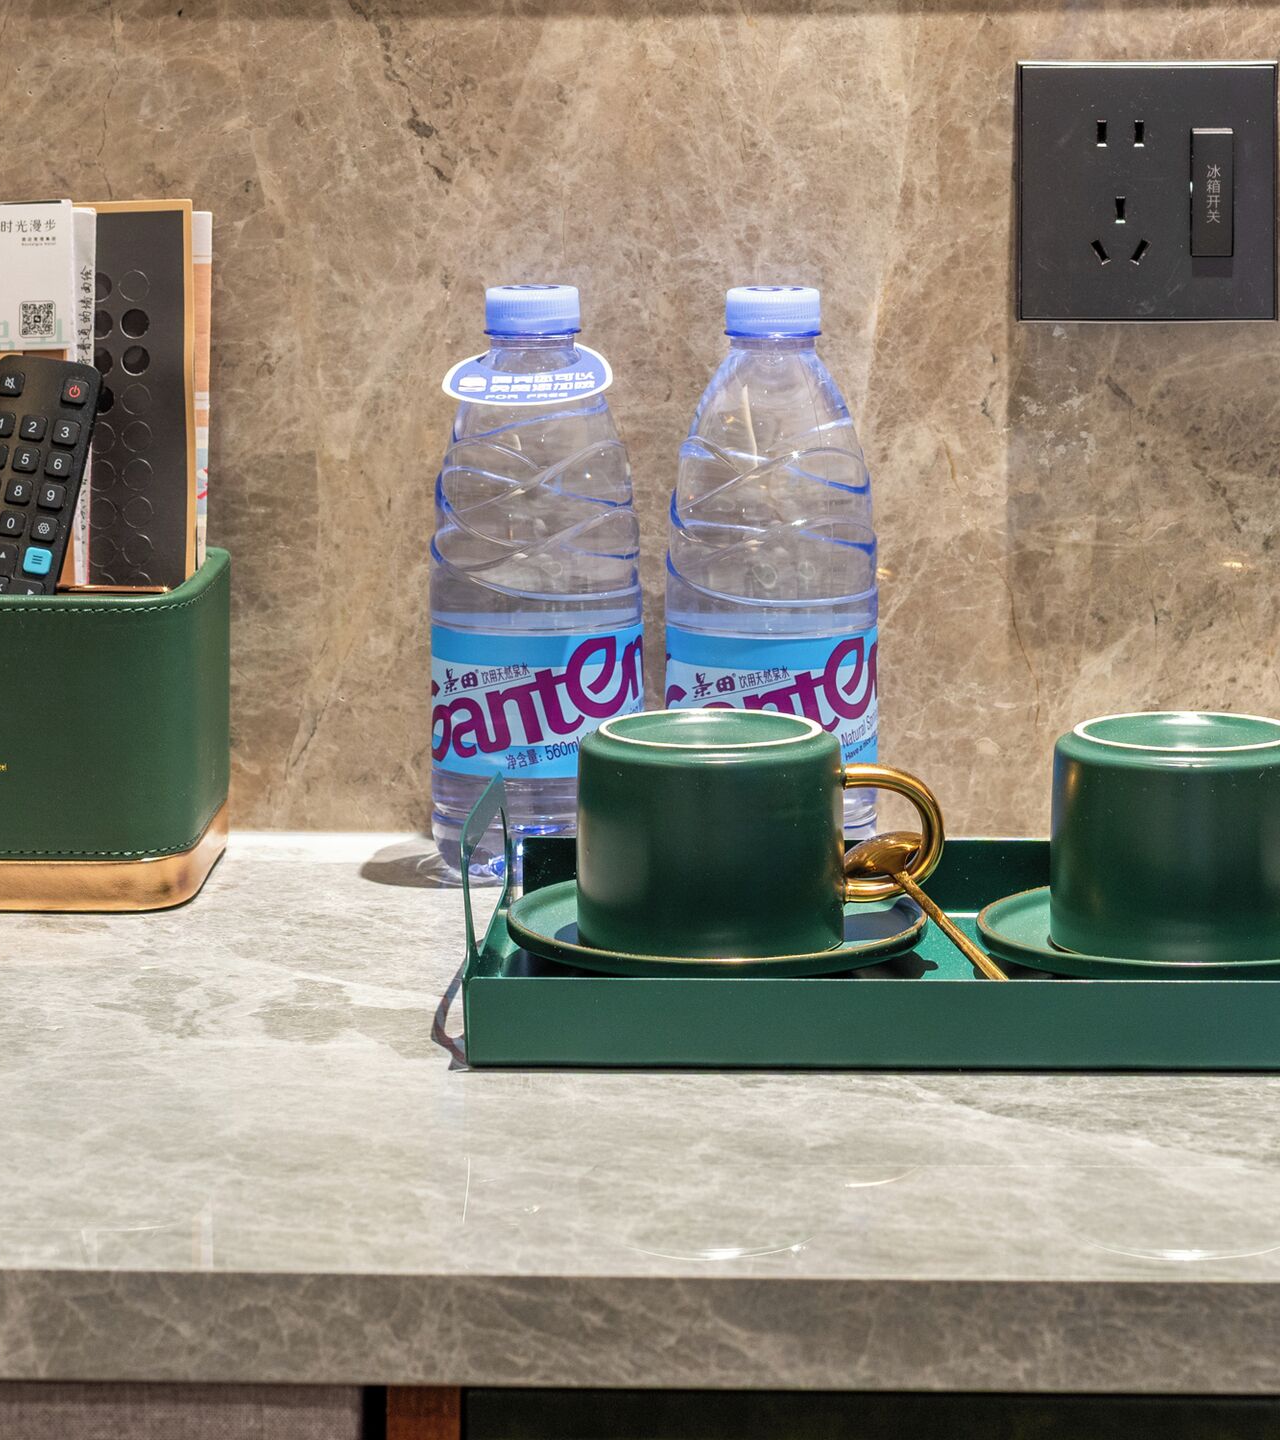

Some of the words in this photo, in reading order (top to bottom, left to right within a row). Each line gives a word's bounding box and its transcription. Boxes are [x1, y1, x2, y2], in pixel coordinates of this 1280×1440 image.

[1206, 164, 1221, 224] 冰箱开关
[0, 219, 56, 233] 时光漫步
[28, 422, 37, 432] 2
[61, 427, 69, 438] 3
[21, 454, 29, 465] 5
[54, 459, 62, 470] 6
[14, 485, 22, 497] 8
[47, 490, 55, 501] 9
[7, 518, 15, 529] 0
[481, 662, 530, 685] 饮用天然泉水
[738, 666, 790, 689] 饮用天然泉水
[841, 719, 866, 748] Natural
[845, 747, 859, 761] Have
